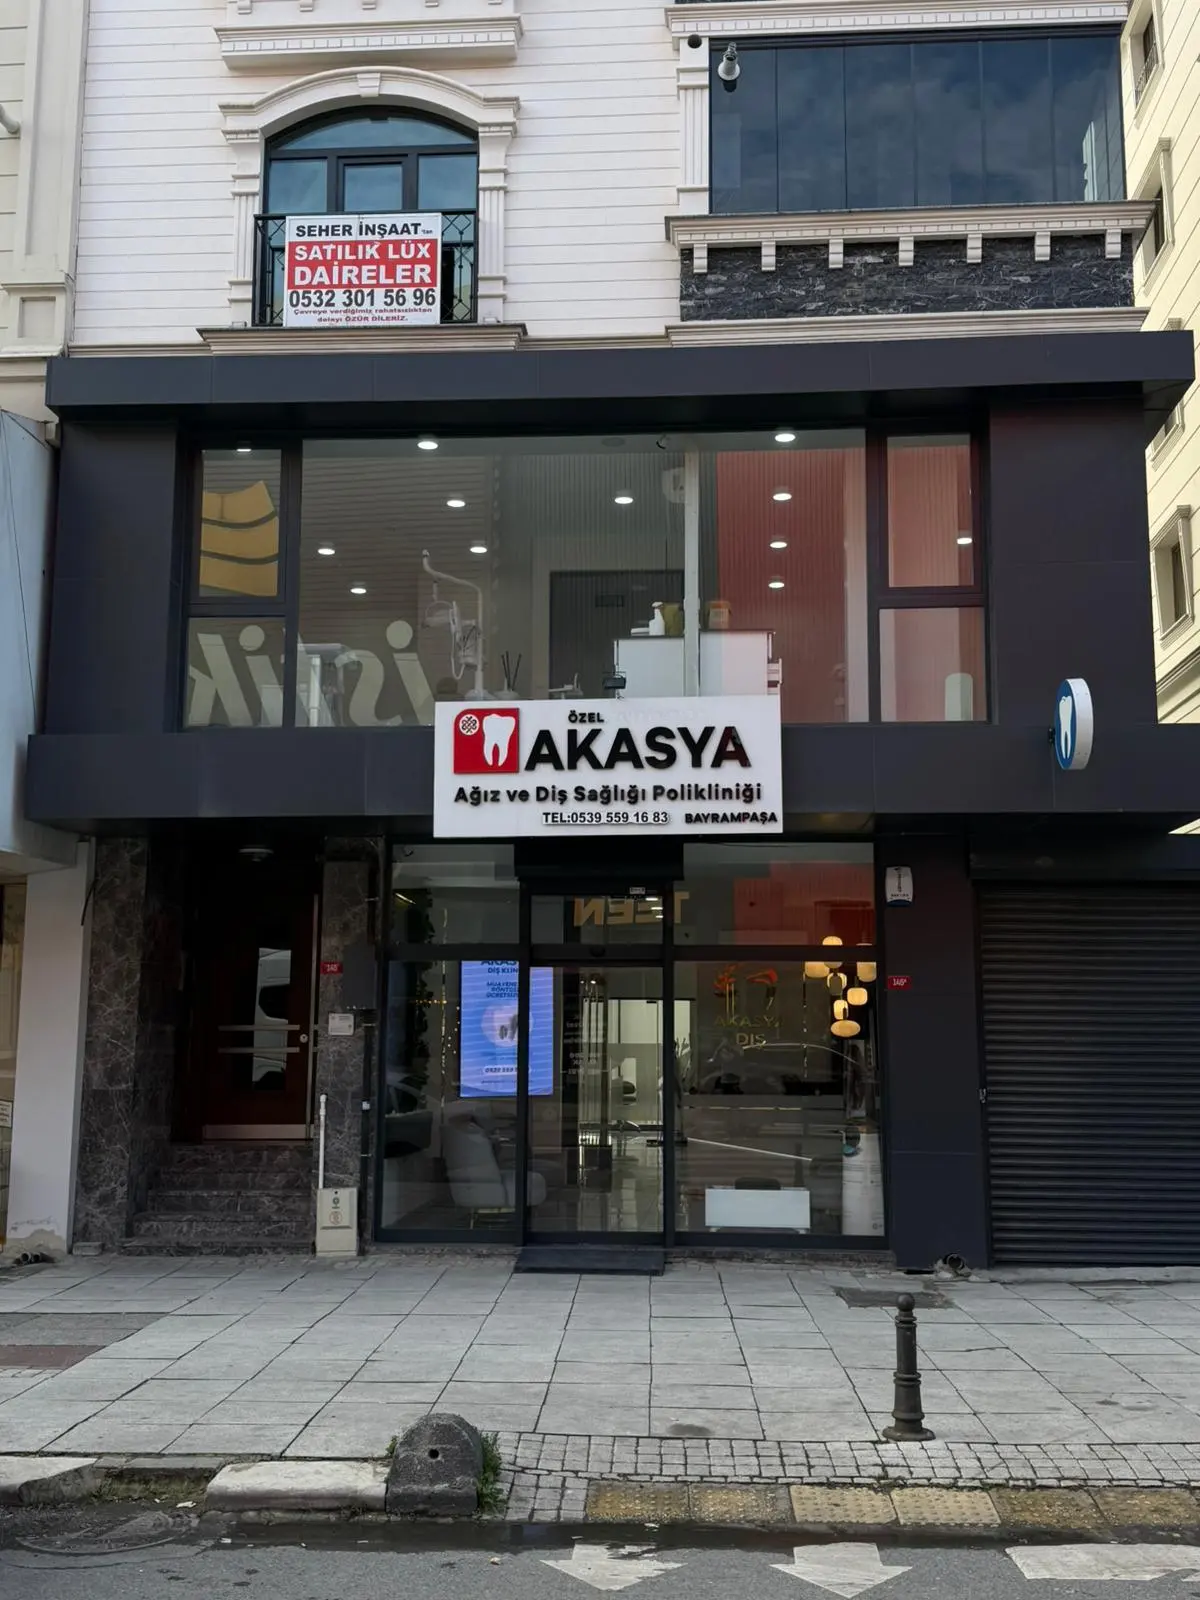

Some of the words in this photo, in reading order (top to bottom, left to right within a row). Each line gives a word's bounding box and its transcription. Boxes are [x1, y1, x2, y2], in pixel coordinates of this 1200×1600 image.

[295, 223, 353, 238] SEHER
[358, 221, 421, 239] İNŞAAT
[294, 243, 381, 261] SATILIK
[388, 240, 431, 259] LÜX
[294, 260, 433, 286] DAİRELER
[289, 290, 336, 308] 0532
[342, 289, 376, 307] 301
[383, 289, 407, 307] 56
[413, 288, 436, 306] 96
[568, 709, 605, 723] ÖZEL
[524, 726, 752, 772] AKASYA
[454, 786, 501, 807] Ağız
[505, 789, 530, 803] ve
[535, 785, 568, 806] Diş
[573, 784, 647, 805] Sağlığı
[652, 782, 763, 804] Polikliniği
[542, 811, 602, 823] TEL:0539
[605, 811, 629, 823] 559
[633, 811, 649, 823] 16
[652, 811, 669, 823] 83
[684, 811, 778, 826] BAYRAMPAŞA
